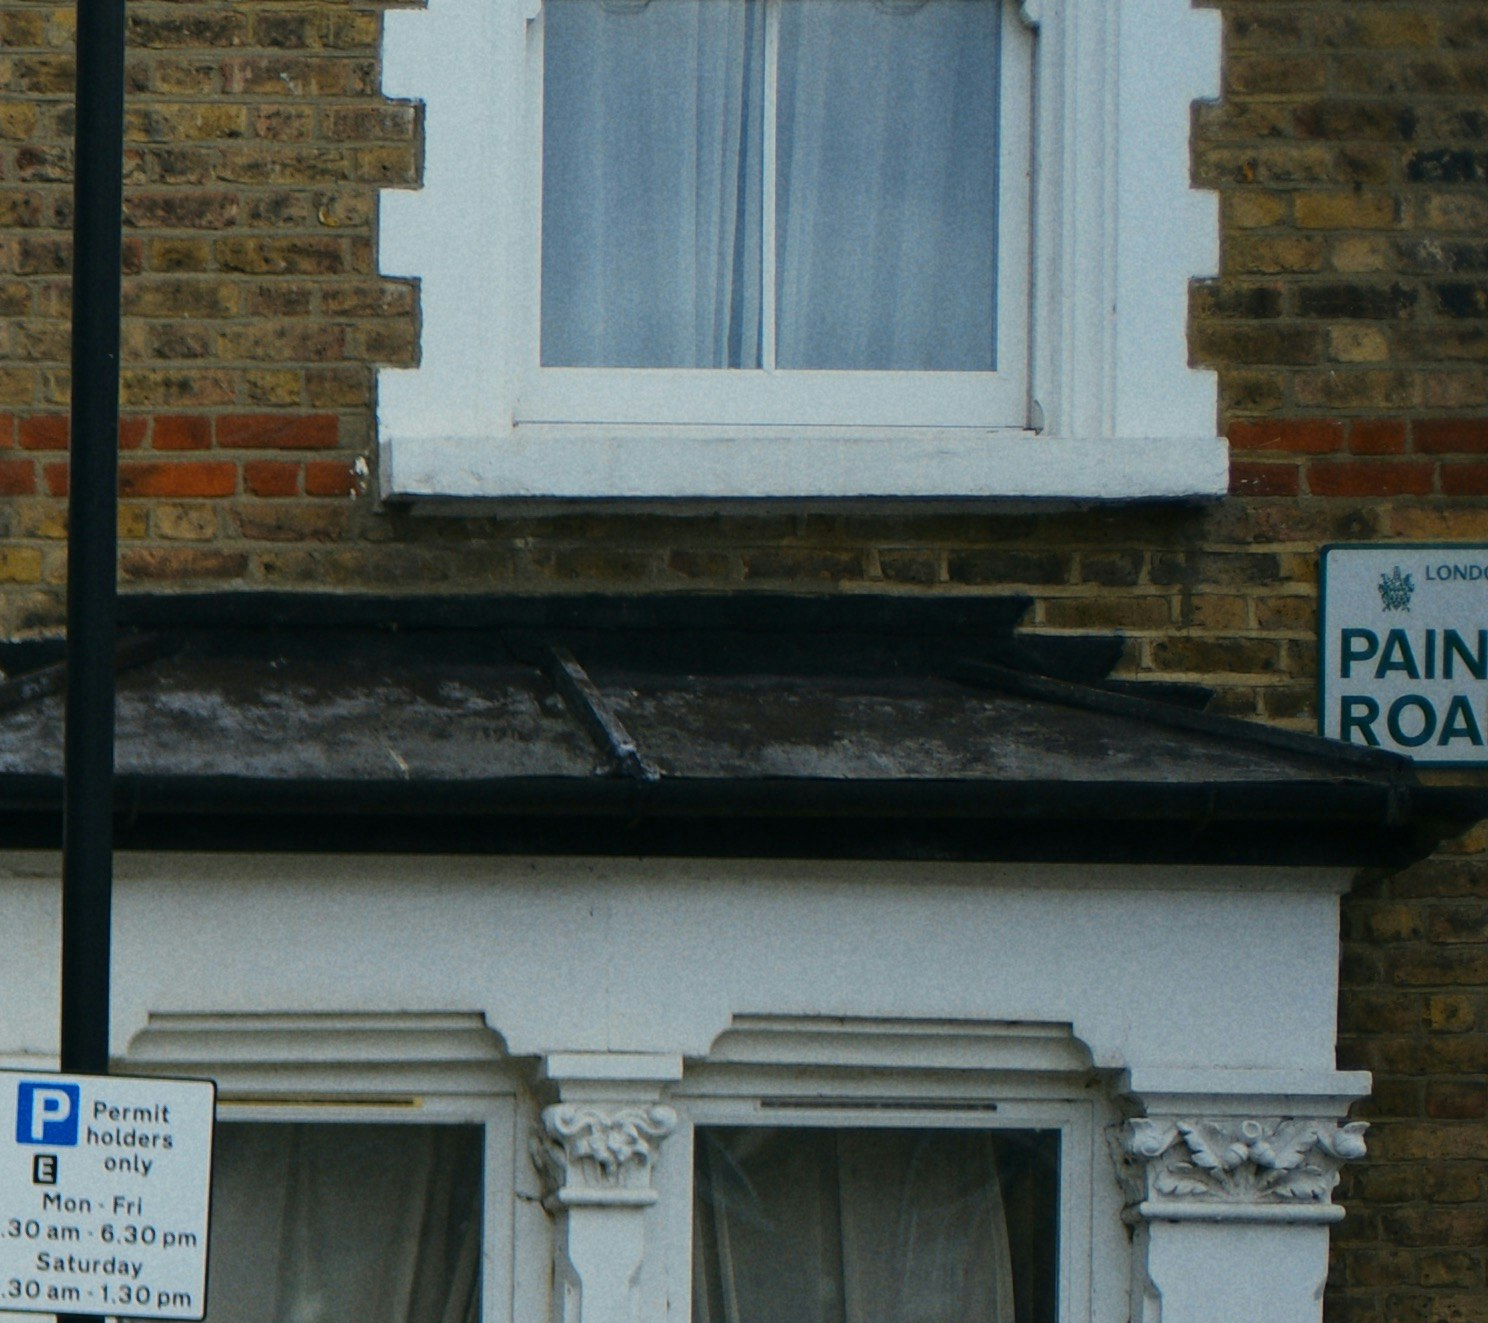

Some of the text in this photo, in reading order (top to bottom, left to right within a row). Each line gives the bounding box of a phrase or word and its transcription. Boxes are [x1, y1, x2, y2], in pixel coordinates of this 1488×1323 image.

[1340, 628, 1488, 680] PAIN
[1340, 694, 1488, 748] ROA
[31, 1088, 71, 1140] P
[93, 1101, 171, 1124] Permit
[86, 1127, 173, 1149] holders
[38, 1157, 54, 1183] E
[104, 1155, 153, 1177] only
[42, 1193, 91, 1213] Mon
[112, 1197, 143, 1216] Fri
[47, 1226, 81, 1241] am
[101, 1225, 156, 1246] 6.30
[163, 1231, 197, 1248] pm
[36, 1253, 144, 1279] Saturday
[47, 1286, 81, 1302] am
[102, 1286, 151, 1305] 1.30
[157, 1291, 192, 1309] pm
